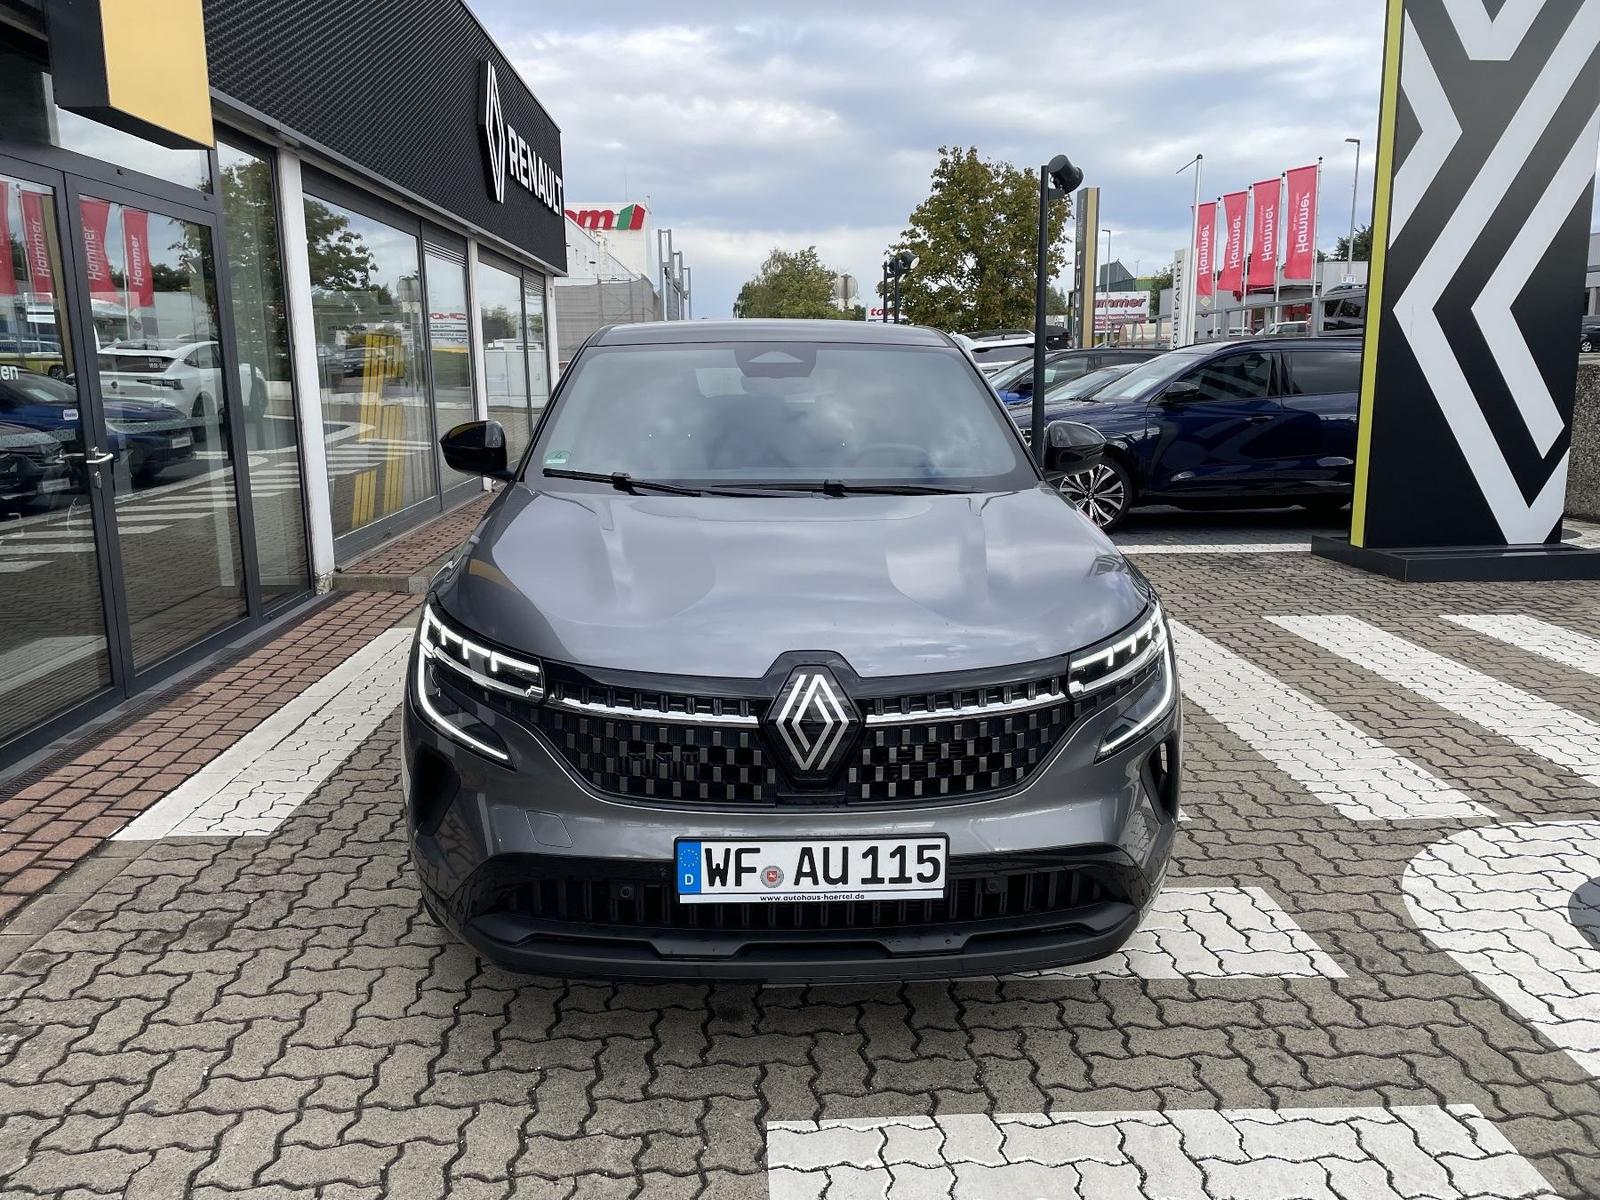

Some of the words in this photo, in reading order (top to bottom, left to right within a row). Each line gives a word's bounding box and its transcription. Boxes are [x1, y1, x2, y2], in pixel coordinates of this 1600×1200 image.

[507, 123, 564, 217] RENAULT
[130, 234, 144, 287] Hammer
[684, 873, 694, 886] D
[704, 846, 761, 888] WF
[794, 846, 848, 886] AU
[860, 844, 941, 885] 115
[760, 893, 865, 902] www.autohaus-haertel.de
